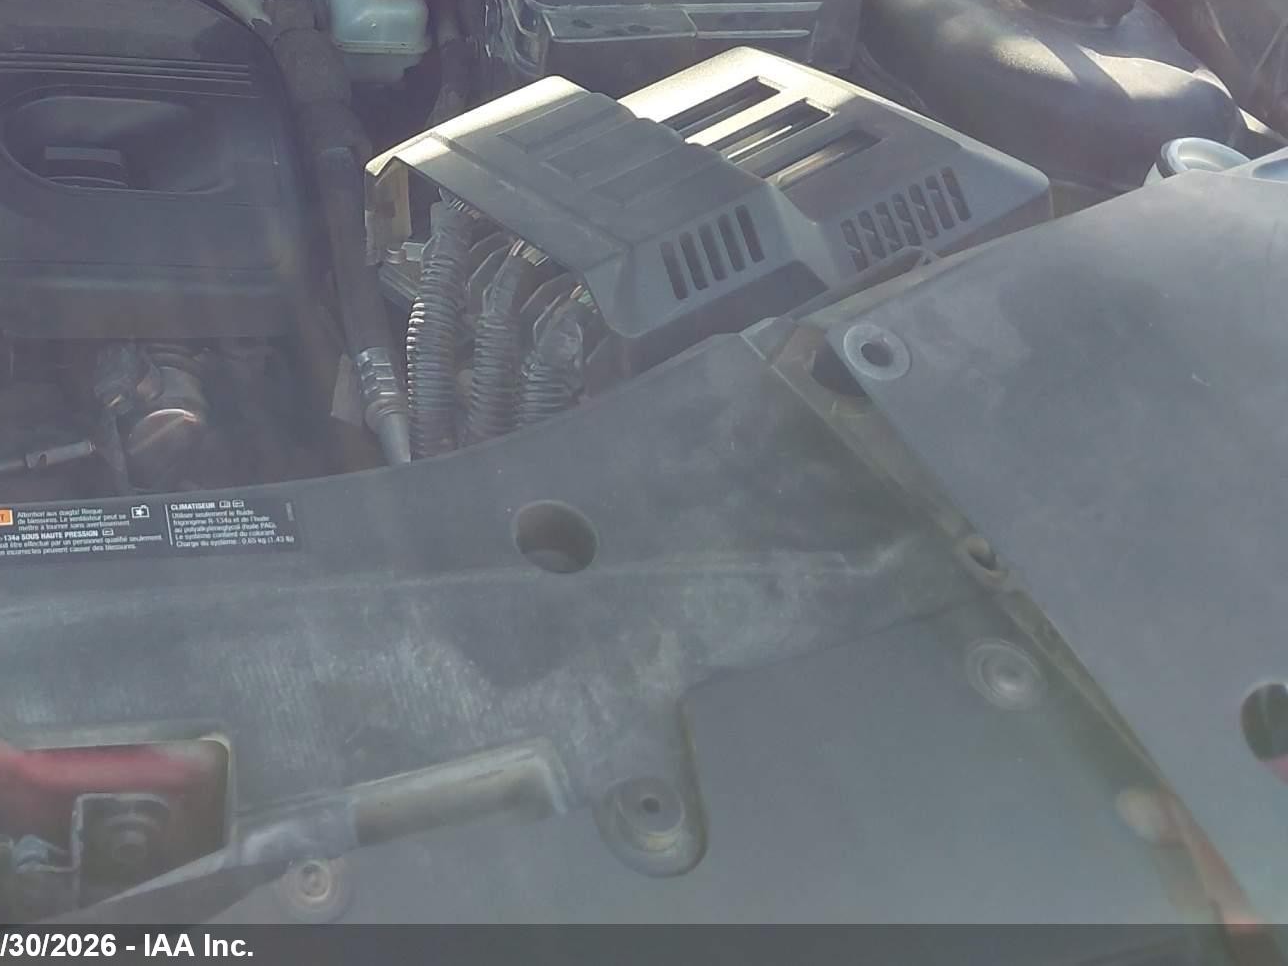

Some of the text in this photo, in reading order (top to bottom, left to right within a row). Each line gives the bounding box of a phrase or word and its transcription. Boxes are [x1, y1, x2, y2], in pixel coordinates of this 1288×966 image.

[171, 502, 215, 511] CLIMATISEUR
[21, 532, 40, 540] SOUS
[41, 531, 63, 539] HAUTE
[64, 530, 99, 538] PRESSION
